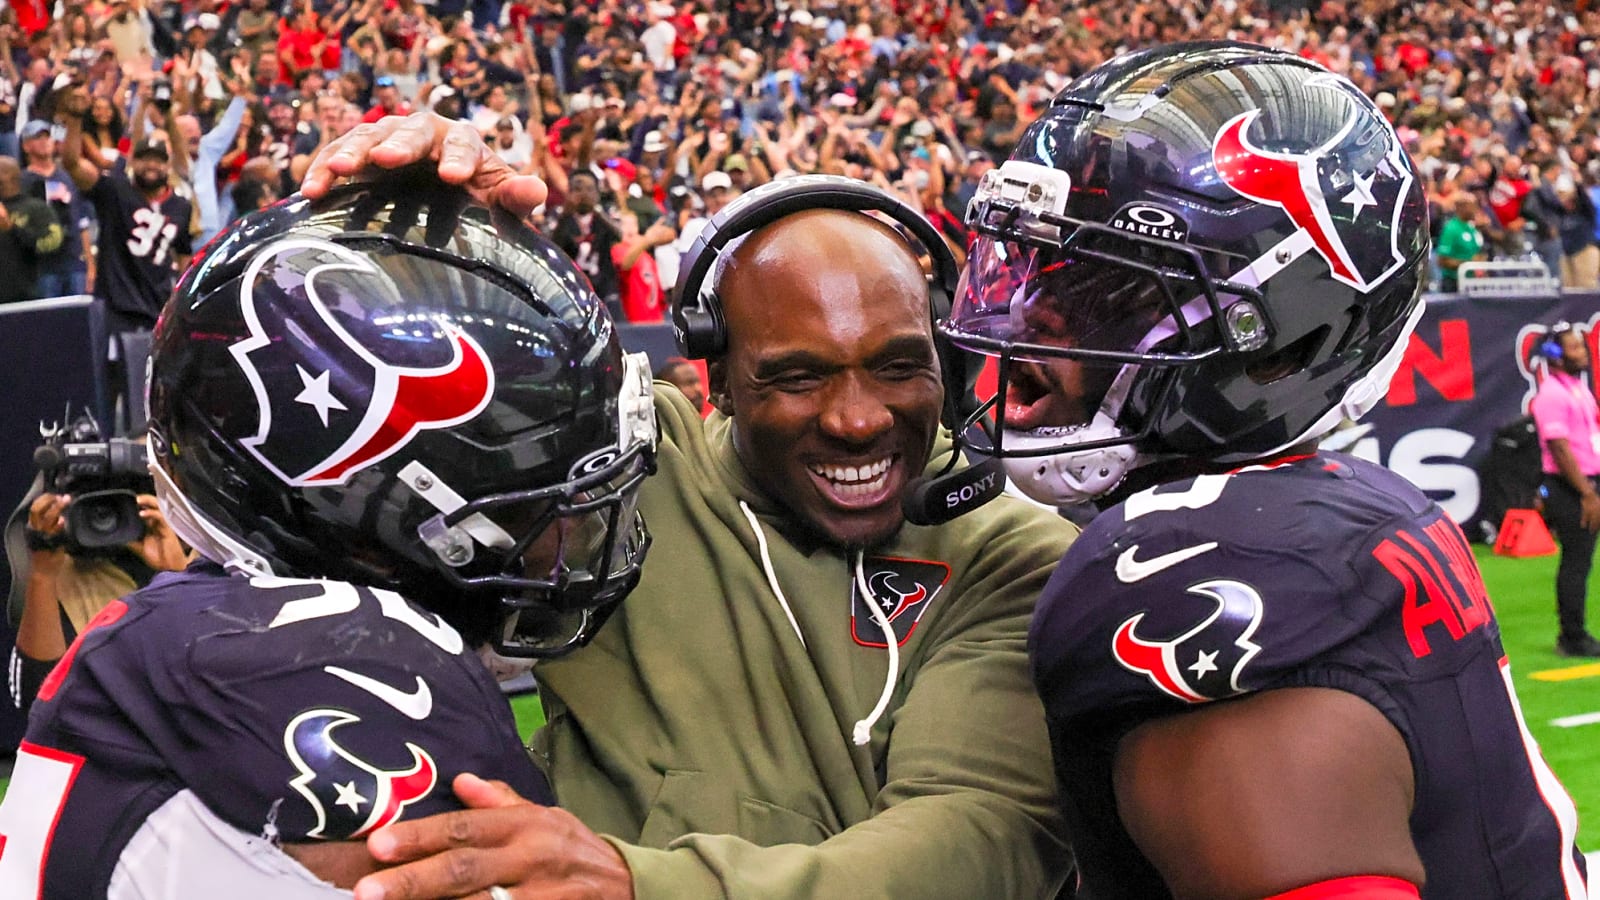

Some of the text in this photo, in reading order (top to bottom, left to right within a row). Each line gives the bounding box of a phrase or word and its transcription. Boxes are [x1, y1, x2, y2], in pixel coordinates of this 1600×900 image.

[126, 207, 178, 265] 31
[1114, 219, 1185, 240] OAKLEY
[946, 471, 996, 509] SONY
